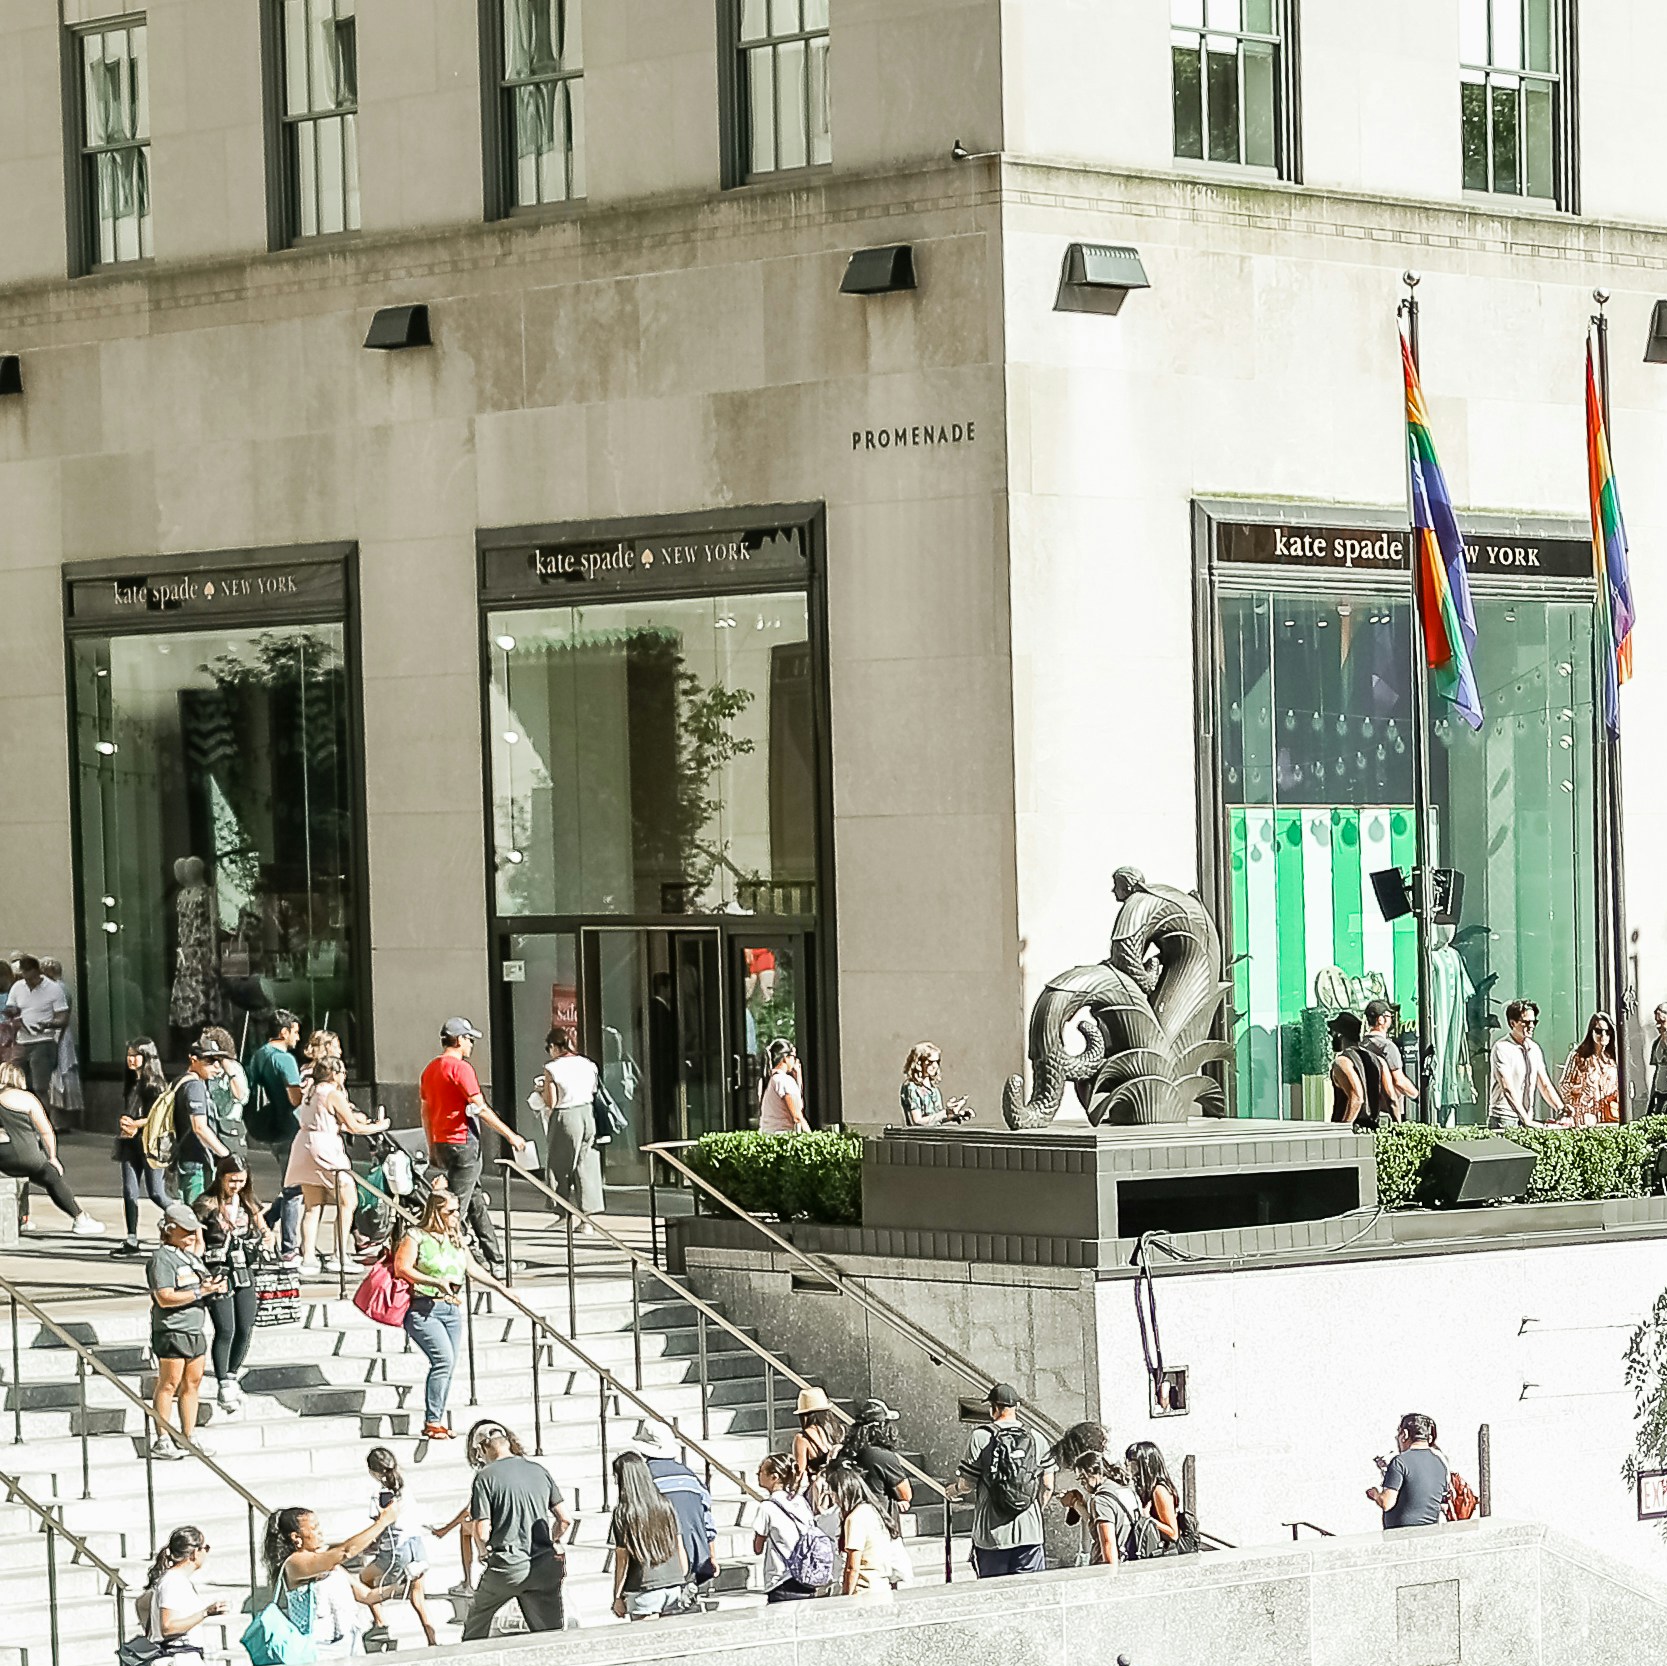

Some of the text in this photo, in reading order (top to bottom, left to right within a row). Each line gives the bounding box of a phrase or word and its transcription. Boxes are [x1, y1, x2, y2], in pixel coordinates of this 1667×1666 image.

[852, 422, 975, 450] PROMENADE
[535, 541, 751, 580] kate spade NEW YORK
[1274, 528, 1327, 558] kate
[1333, 533, 1403, 568] spade
[1486, 546, 1540, 566] YORK
[113, 575, 297, 610] kate spade NEW YORK
